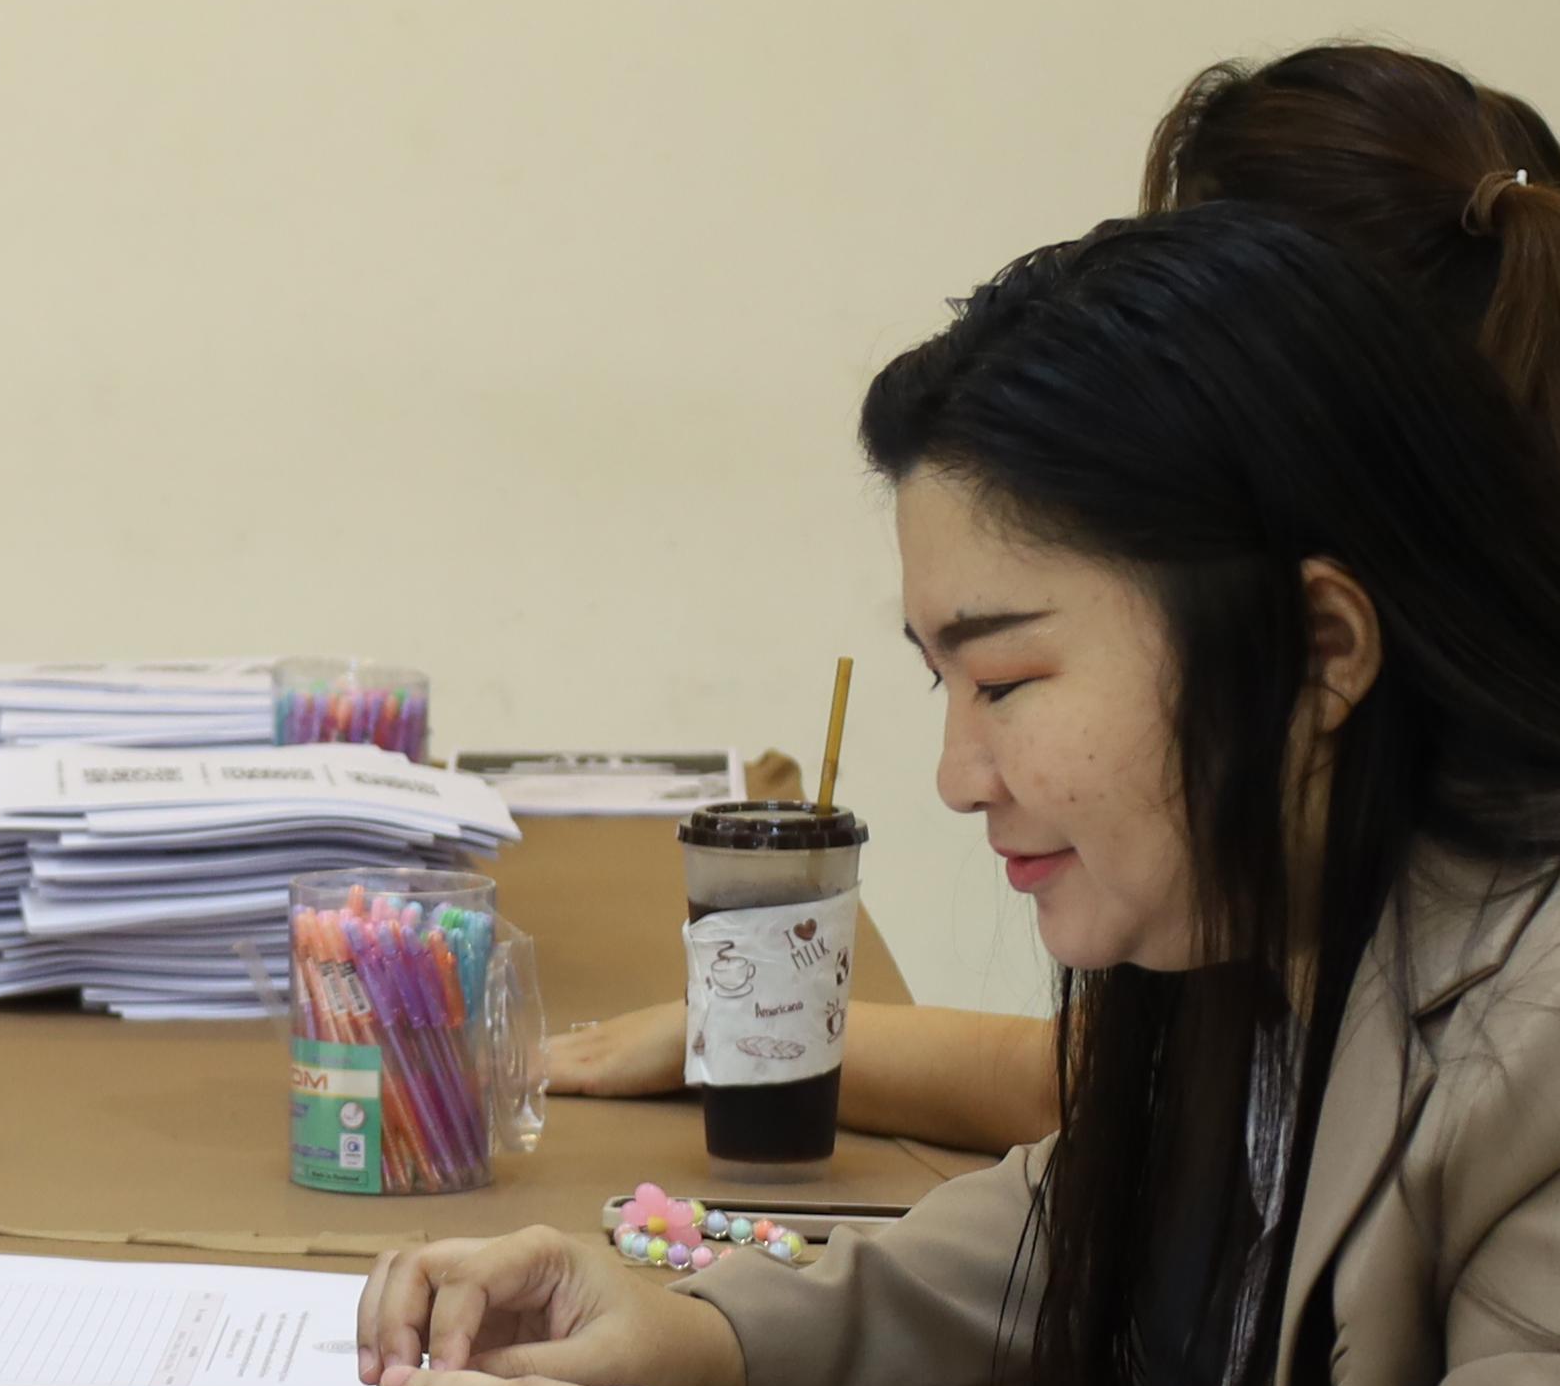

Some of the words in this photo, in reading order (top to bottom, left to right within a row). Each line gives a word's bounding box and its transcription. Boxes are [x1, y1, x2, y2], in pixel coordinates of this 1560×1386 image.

[784, 930, 795, 949] I
[791, 937, 830, 970] MILK
[755, 1001, 804, 1018] Americano
